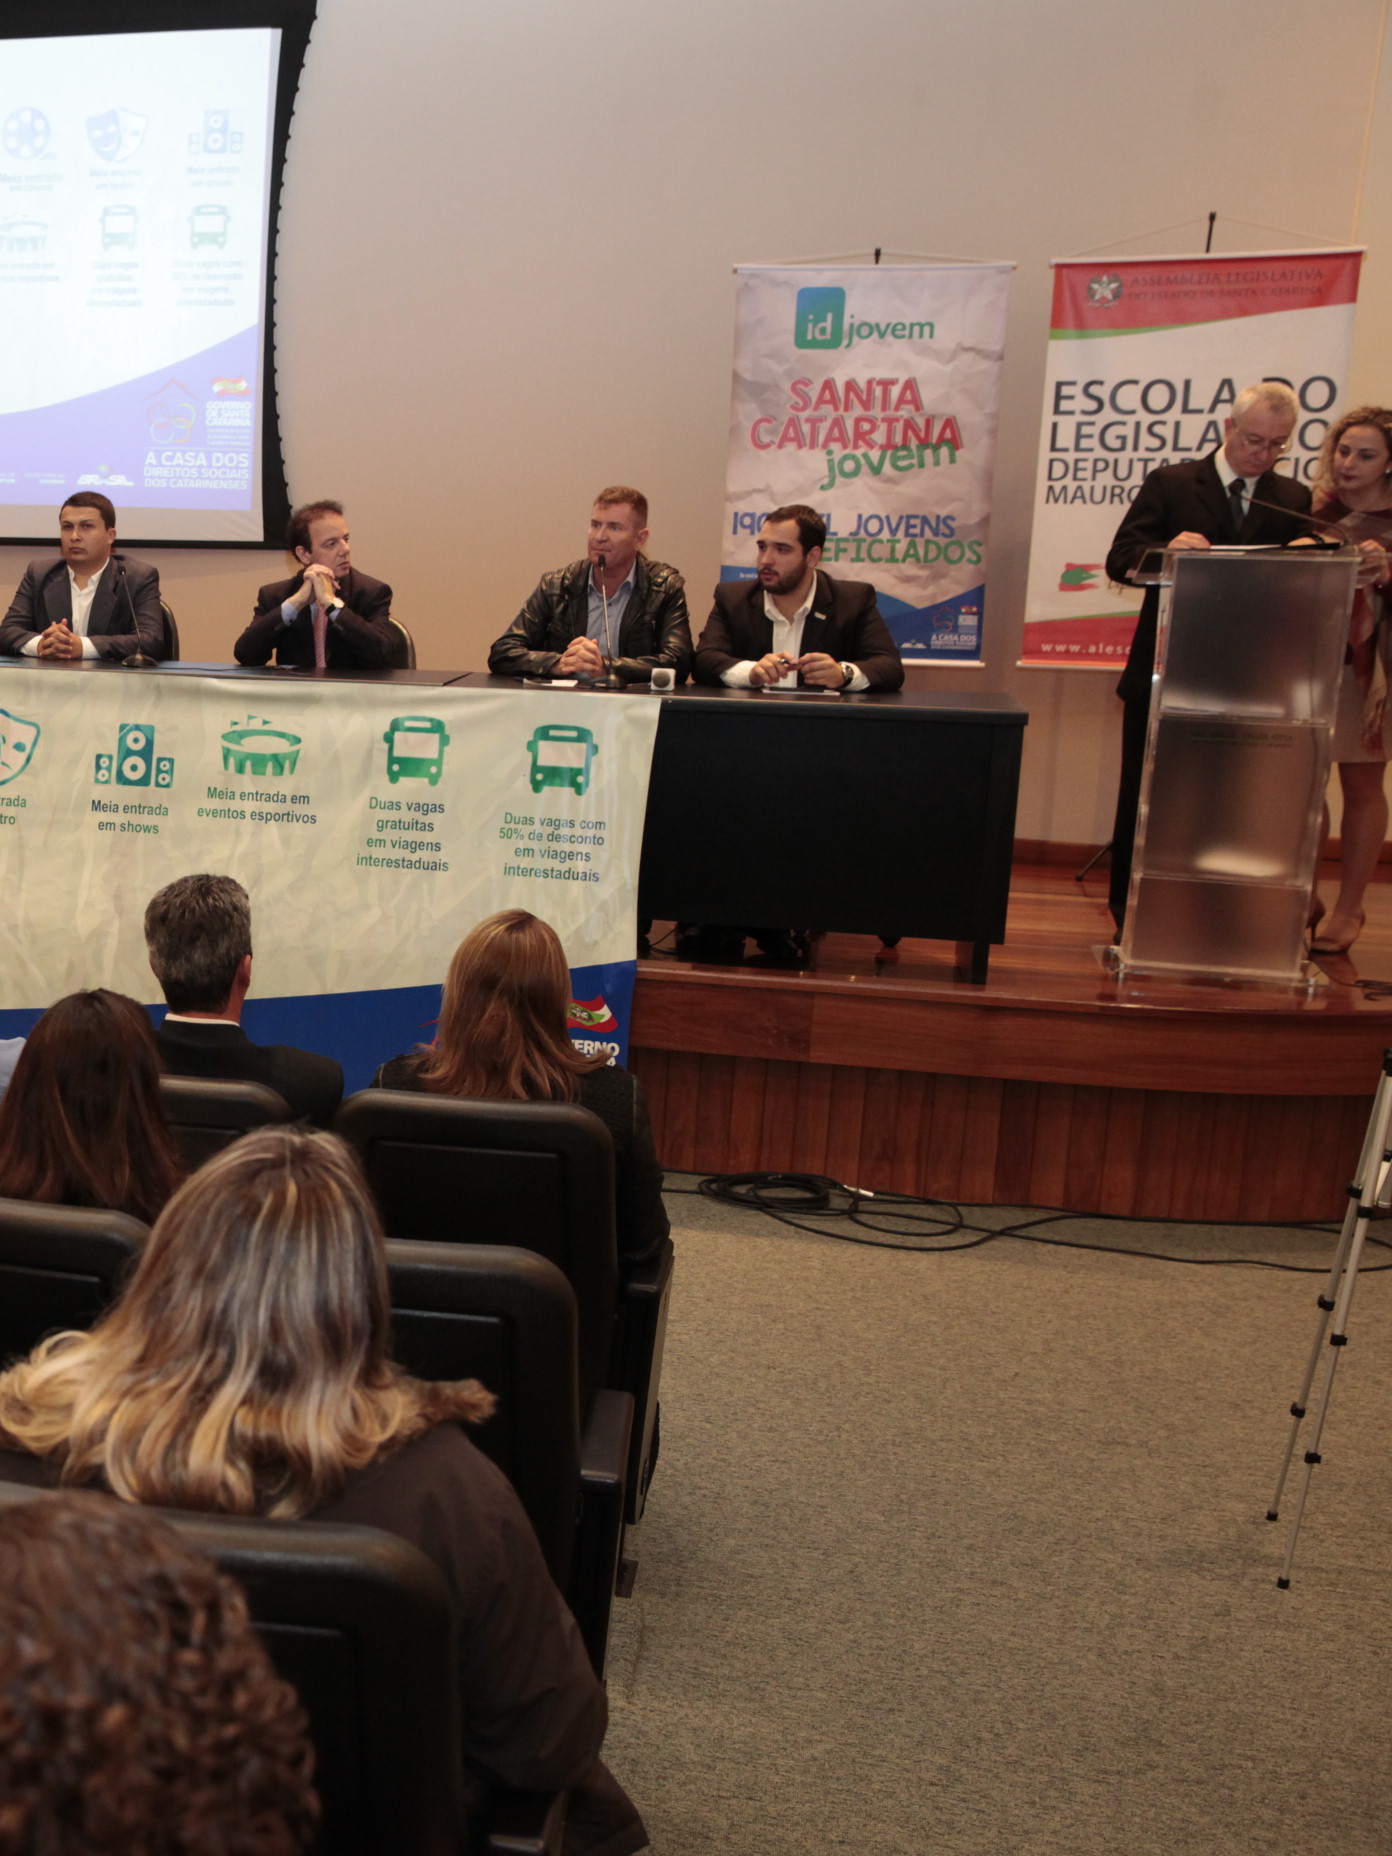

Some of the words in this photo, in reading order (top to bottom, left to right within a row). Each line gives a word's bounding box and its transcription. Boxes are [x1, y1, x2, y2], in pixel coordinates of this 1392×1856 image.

[1130, 272, 1221, 287] ASSEMBLEIA
[1226, 268, 1325, 284] LEGISLATIVA
[1151, 290, 1196, 300] ESTADO
[1220, 289, 1258, 299] SANTA
[1260, 286, 1323, 298] CATARINA
[805, 312, 833, 340] id
[843, 314, 935, 349] jovem
[788, 376, 924, 414] SANTA
[1052, 378, 1236, 416] ESCOLA
[749, 414, 964, 451] CATARINA
[1049, 418, 1330, 453] LEGISLAO
[144, 451, 157, 466] A
[160, 451, 207, 467] CASA
[212, 452, 249, 467] DOS
[818, 440, 957, 491] jovem
[143, 466, 199, 478] DIREITOS
[200, 467, 249, 479] SOCIAIS
[144, 478, 167, 488] DOS
[169, 479, 248, 490] CATARINENSES
[849, 513, 956, 539] JOVENS
[820, 537, 984, 565] EFICIADOS
[207, 786, 236, 801] Meia
[239, 789, 287, 804] entrada
[290, 793, 311, 806] em
[91, 799, 119, 813] Meia
[123, 801, 169, 817] entrada
[196, 806, 247, 820] eventos
[250, 810, 317, 825] esportivos
[369, 796, 402, 812] Duas
[406, 800, 446, 816] vagas
[98, 819, 116, 831] em
[119, 819, 159, 835] shows
[376, 816, 435, 833] gratuitas
[504, 812, 536, 827] Duas
[539, 817, 576, 831] vagas
[579, 818, 607, 832] com
[366, 837, 387, 849] em
[390, 836, 442, 854] viagens
[498, 827, 525, 841] 50%
[528, 828, 544, 842] de
[546, 830, 605, 846] desconto
[356, 853, 450, 873] interestaduais
[514, 847, 535, 859] em
[538, 847, 592, 864] viagens
[503, 862, 600, 883] interestaduais
[570, 1039, 620, 1057] ERNO
